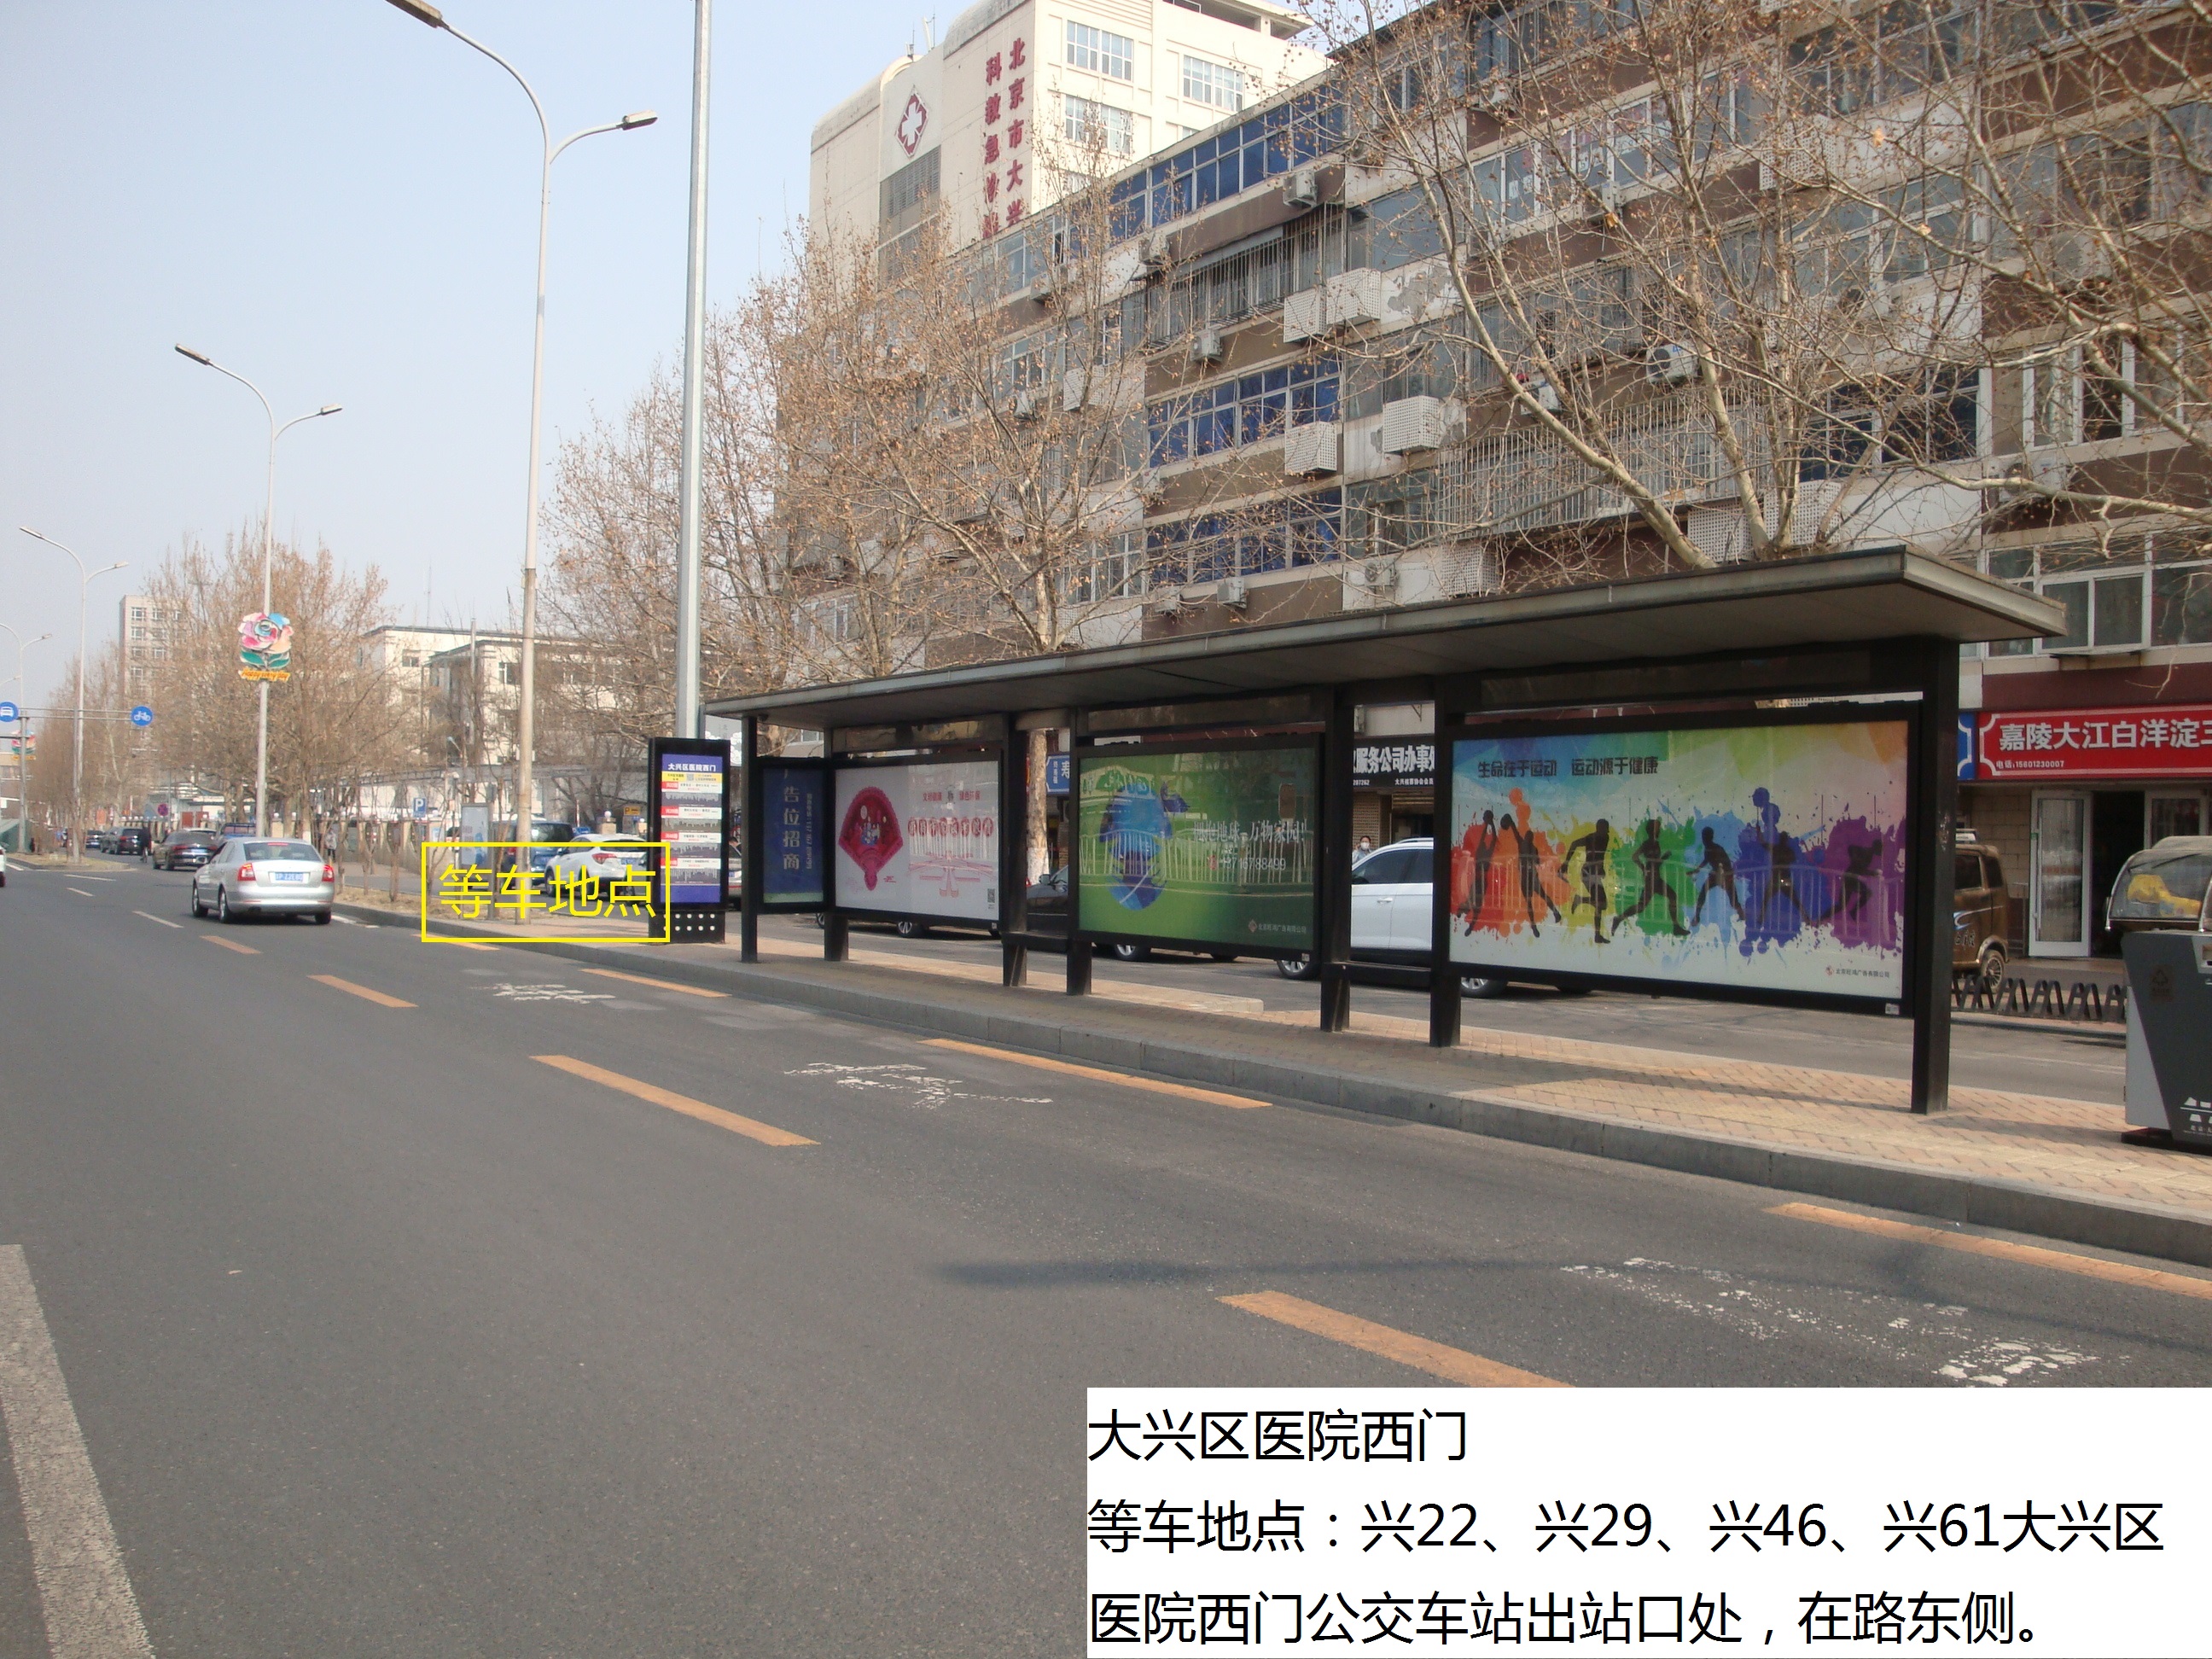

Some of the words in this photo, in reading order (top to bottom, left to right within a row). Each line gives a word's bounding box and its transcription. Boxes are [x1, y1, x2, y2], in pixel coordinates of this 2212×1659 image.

[667, 763, 716, 771] 大兴区医院西门
[1353, 745, 1435, 773] 服务公司办事
[1478, 760, 1557, 777] 生命在于运动
[1571, 756, 1659, 776] 运动源于健康
